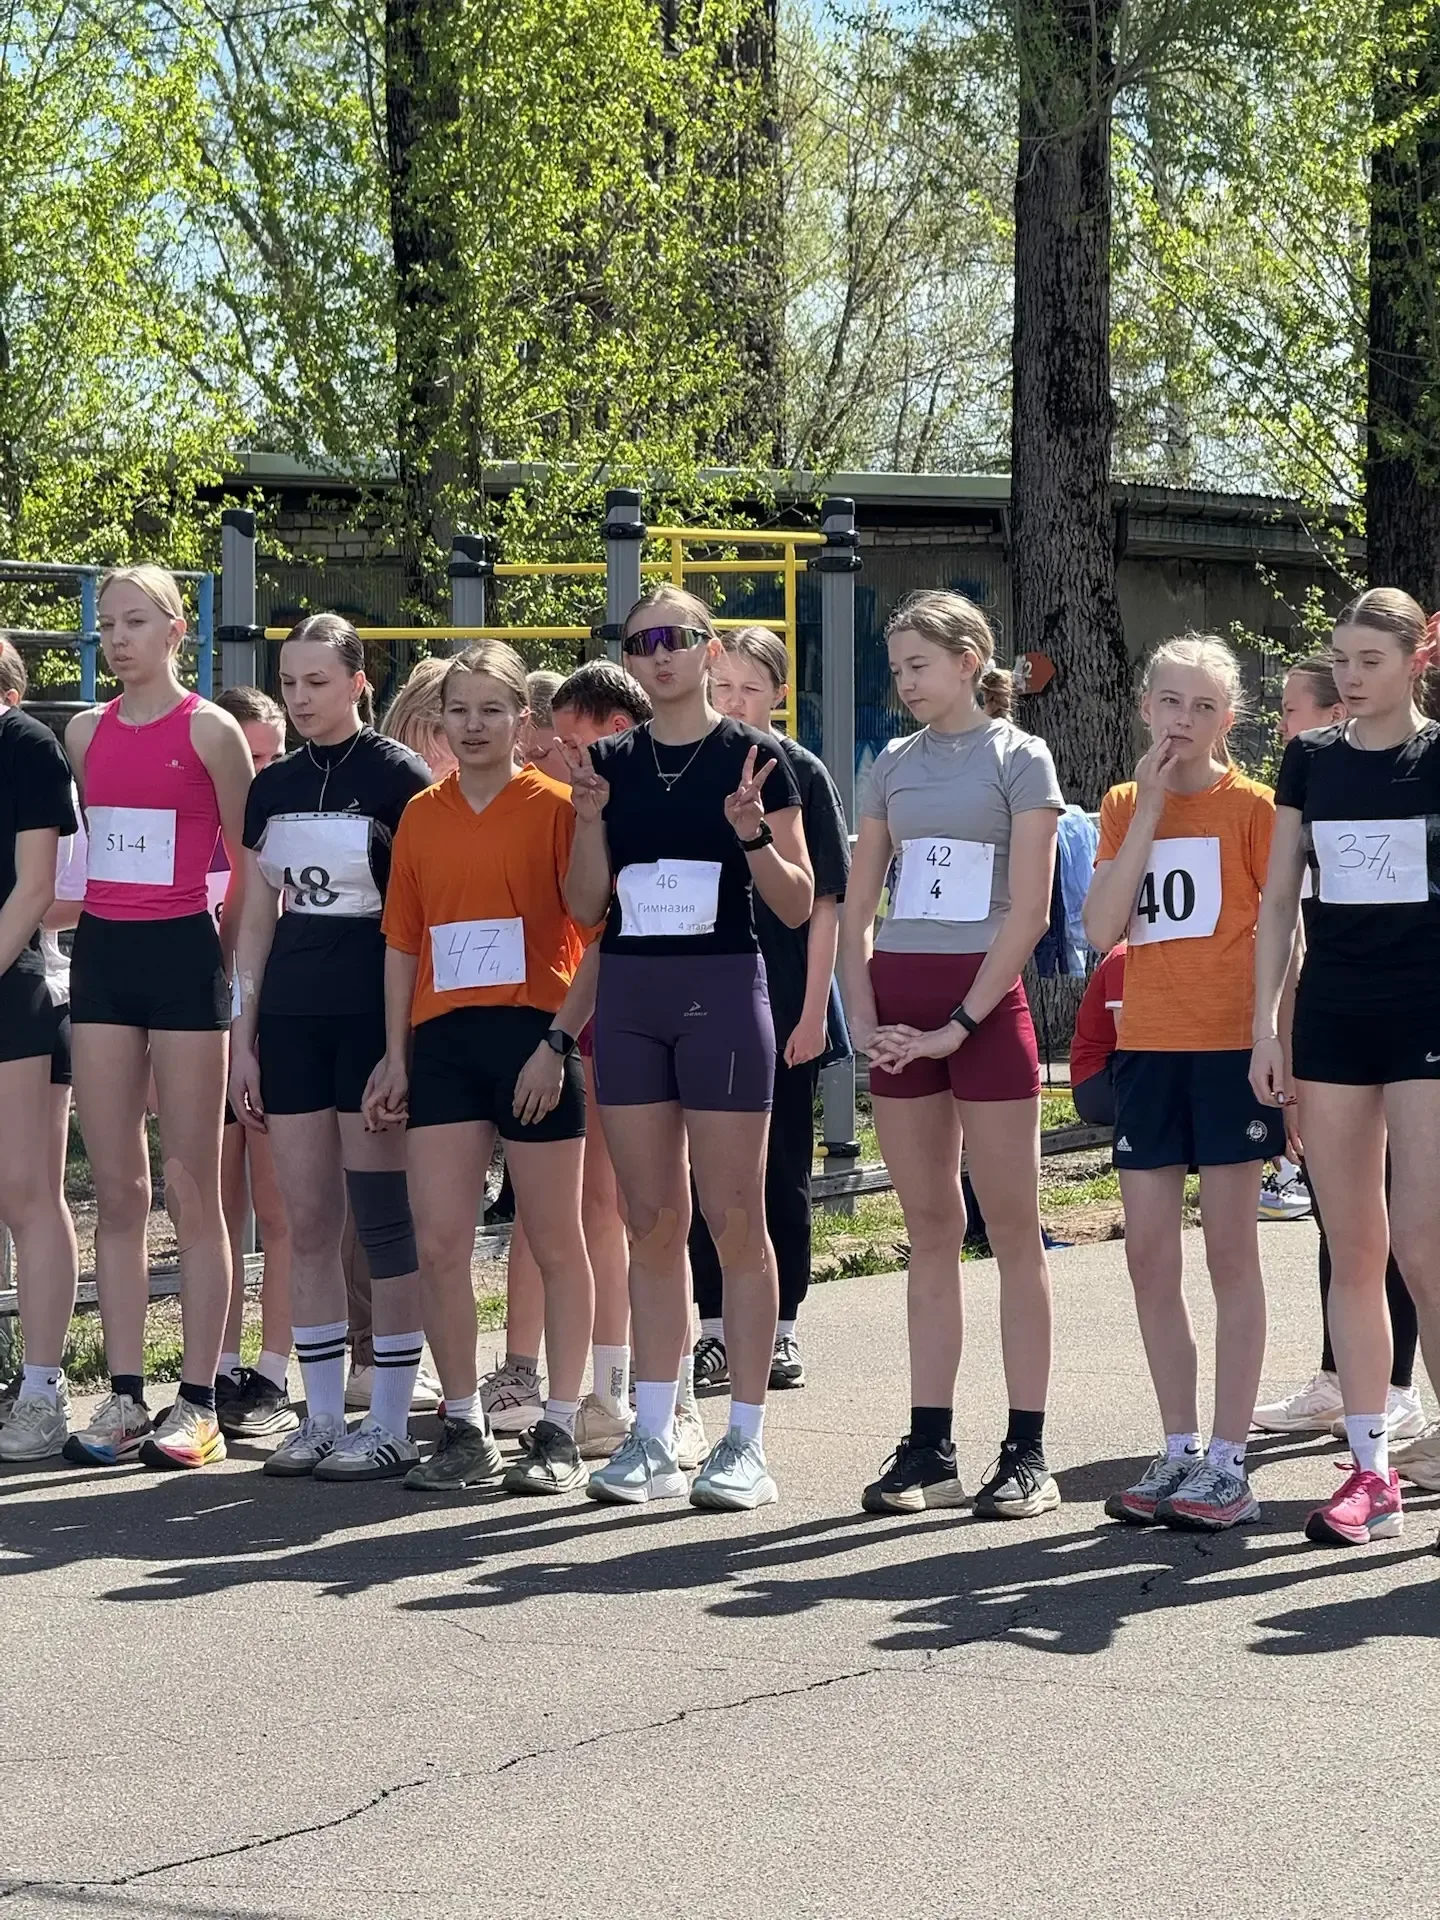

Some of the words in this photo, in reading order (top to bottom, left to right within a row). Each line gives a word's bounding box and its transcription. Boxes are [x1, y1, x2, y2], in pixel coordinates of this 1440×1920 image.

[106, 833, 146, 853] 51-4
[926, 845, 952, 867] 42
[656, 873, 678, 889] 46
[930, 879, 943, 899] 4
[1138, 869, 1196, 924] 40
[637, 902, 696, 913] Гимназия
[678, 922, 684, 930] 4
[447, 928, 501, 977] 47
[489, 960, 500, 979] 4
